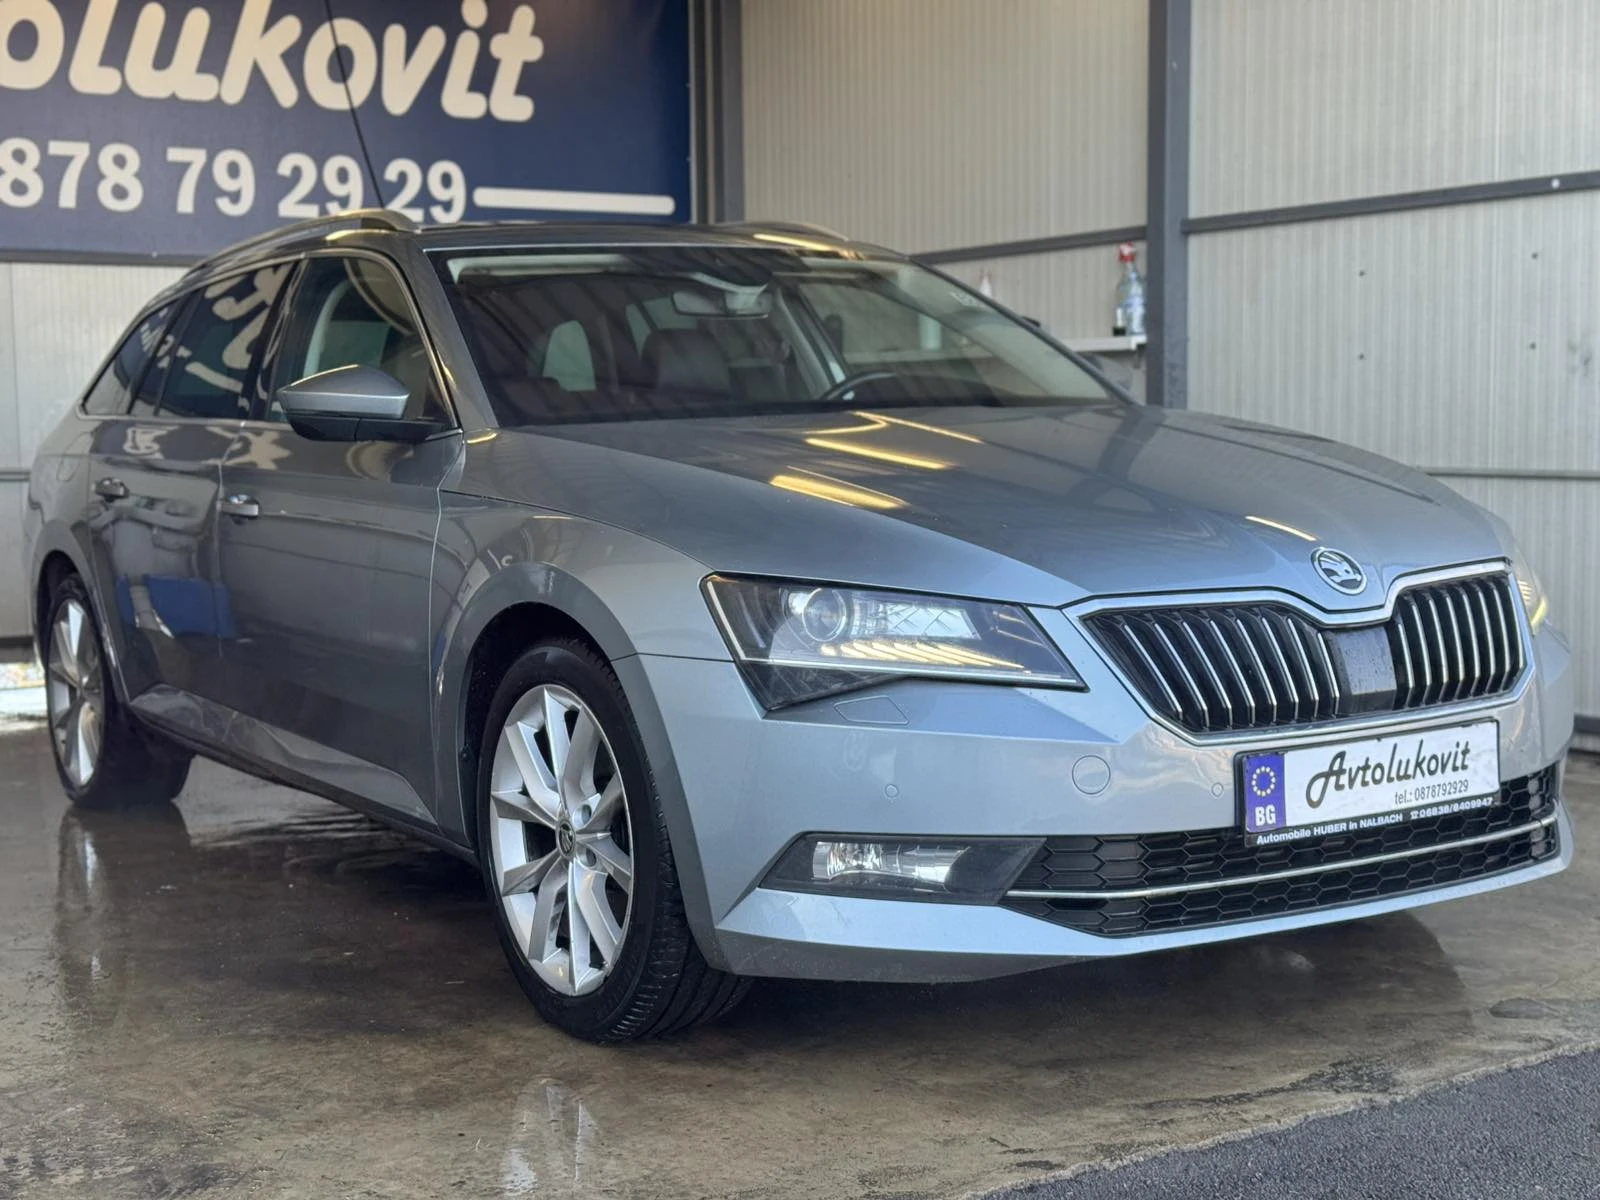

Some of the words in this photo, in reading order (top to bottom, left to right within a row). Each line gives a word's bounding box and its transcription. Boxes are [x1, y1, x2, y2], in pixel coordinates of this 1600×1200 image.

[167, 147, 256, 216] 79
[276, 152, 364, 218] 29
[383, 157, 466, 224] 29
[1305, 739, 1470, 808] Avtolukovit
[1414, 779, 1469, 801] 0878792929
[1255, 805, 1277, 826] BG
[1256, 828, 1311, 845] Automobile
[1313, 822, 1347, 836] HUBER
[1349, 821, 1358, 830] in
[1360, 813, 1403, 829] NALBACH
